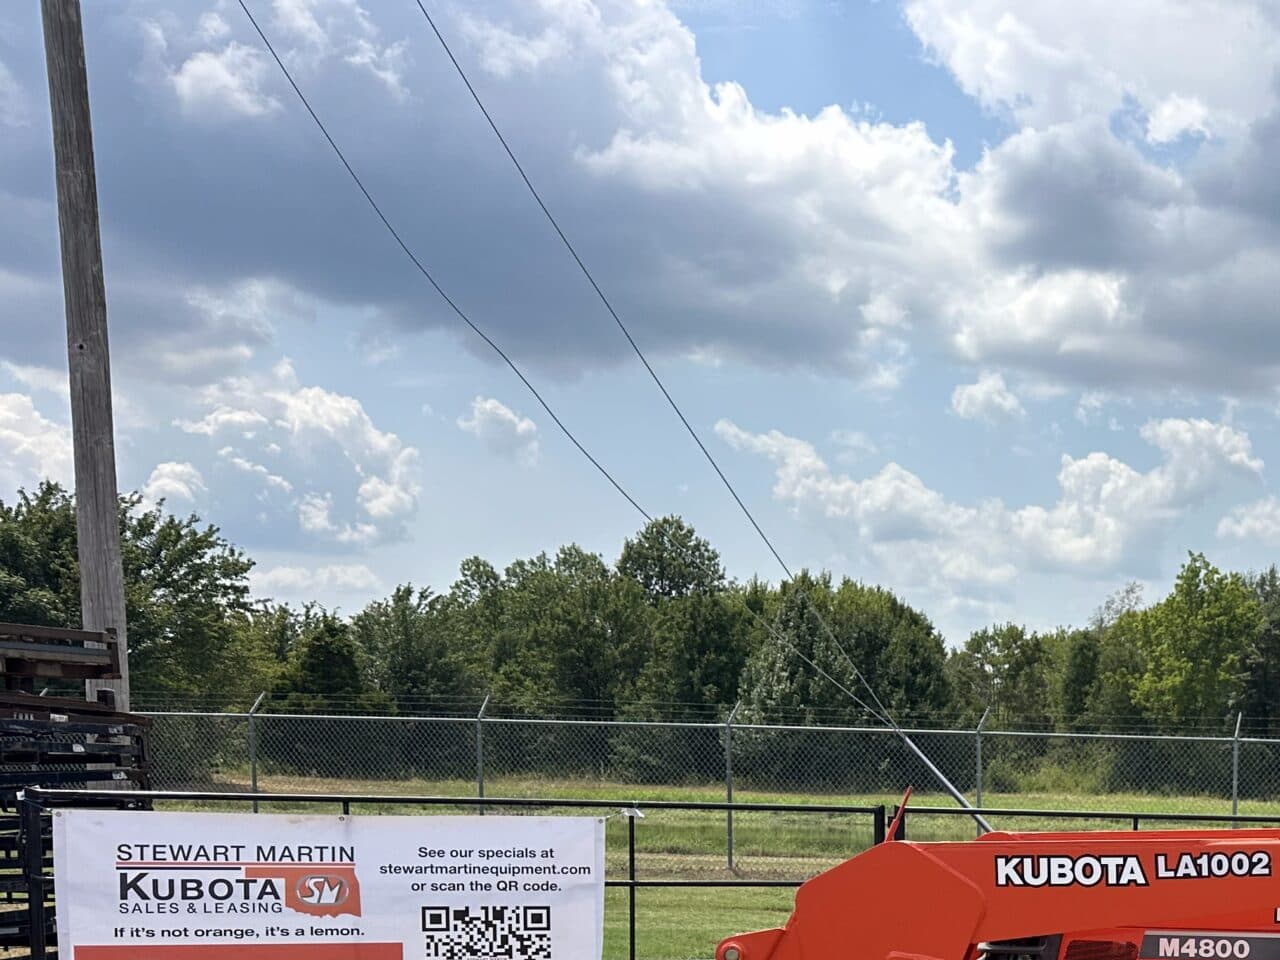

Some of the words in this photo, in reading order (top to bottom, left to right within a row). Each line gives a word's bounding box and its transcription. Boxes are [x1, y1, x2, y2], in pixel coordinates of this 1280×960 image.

[117, 844, 245, 862] STEWART
[256, 845, 355, 862] MARTIN
[418, 847, 446, 858] See
[450, 849, 474, 858] our
[478, 847, 537, 860] specials
[540, 848, 555, 858] at
[379, 863, 591, 876] stewartmartinequipment.com
[995, 854, 1149, 887] KUBOTA
[1156, 851, 1271, 879] LA1002
[119, 872, 280, 901] KUBOTA
[300, 876, 343, 904] SM
[411, 882, 427, 892] or
[430, 882, 465, 892] scan
[469, 881, 492, 892] the
[496, 881, 518, 892] QR
[523, 881, 562, 892] code.
[119, 902, 180, 914] SALES
[187, 902, 198, 914] &
[203, 902, 283, 914] LEASING
[114, 927, 125, 938] If
[130, 927, 155, 938] it's
[161, 928, 190, 938] not
[194, 928, 260, 939] orange,
[265, 926, 290, 937] it's
[295, 929, 305, 937] a
[310, 926, 365, 938] lemon.
[1158, 938, 1250, 958] M4800
